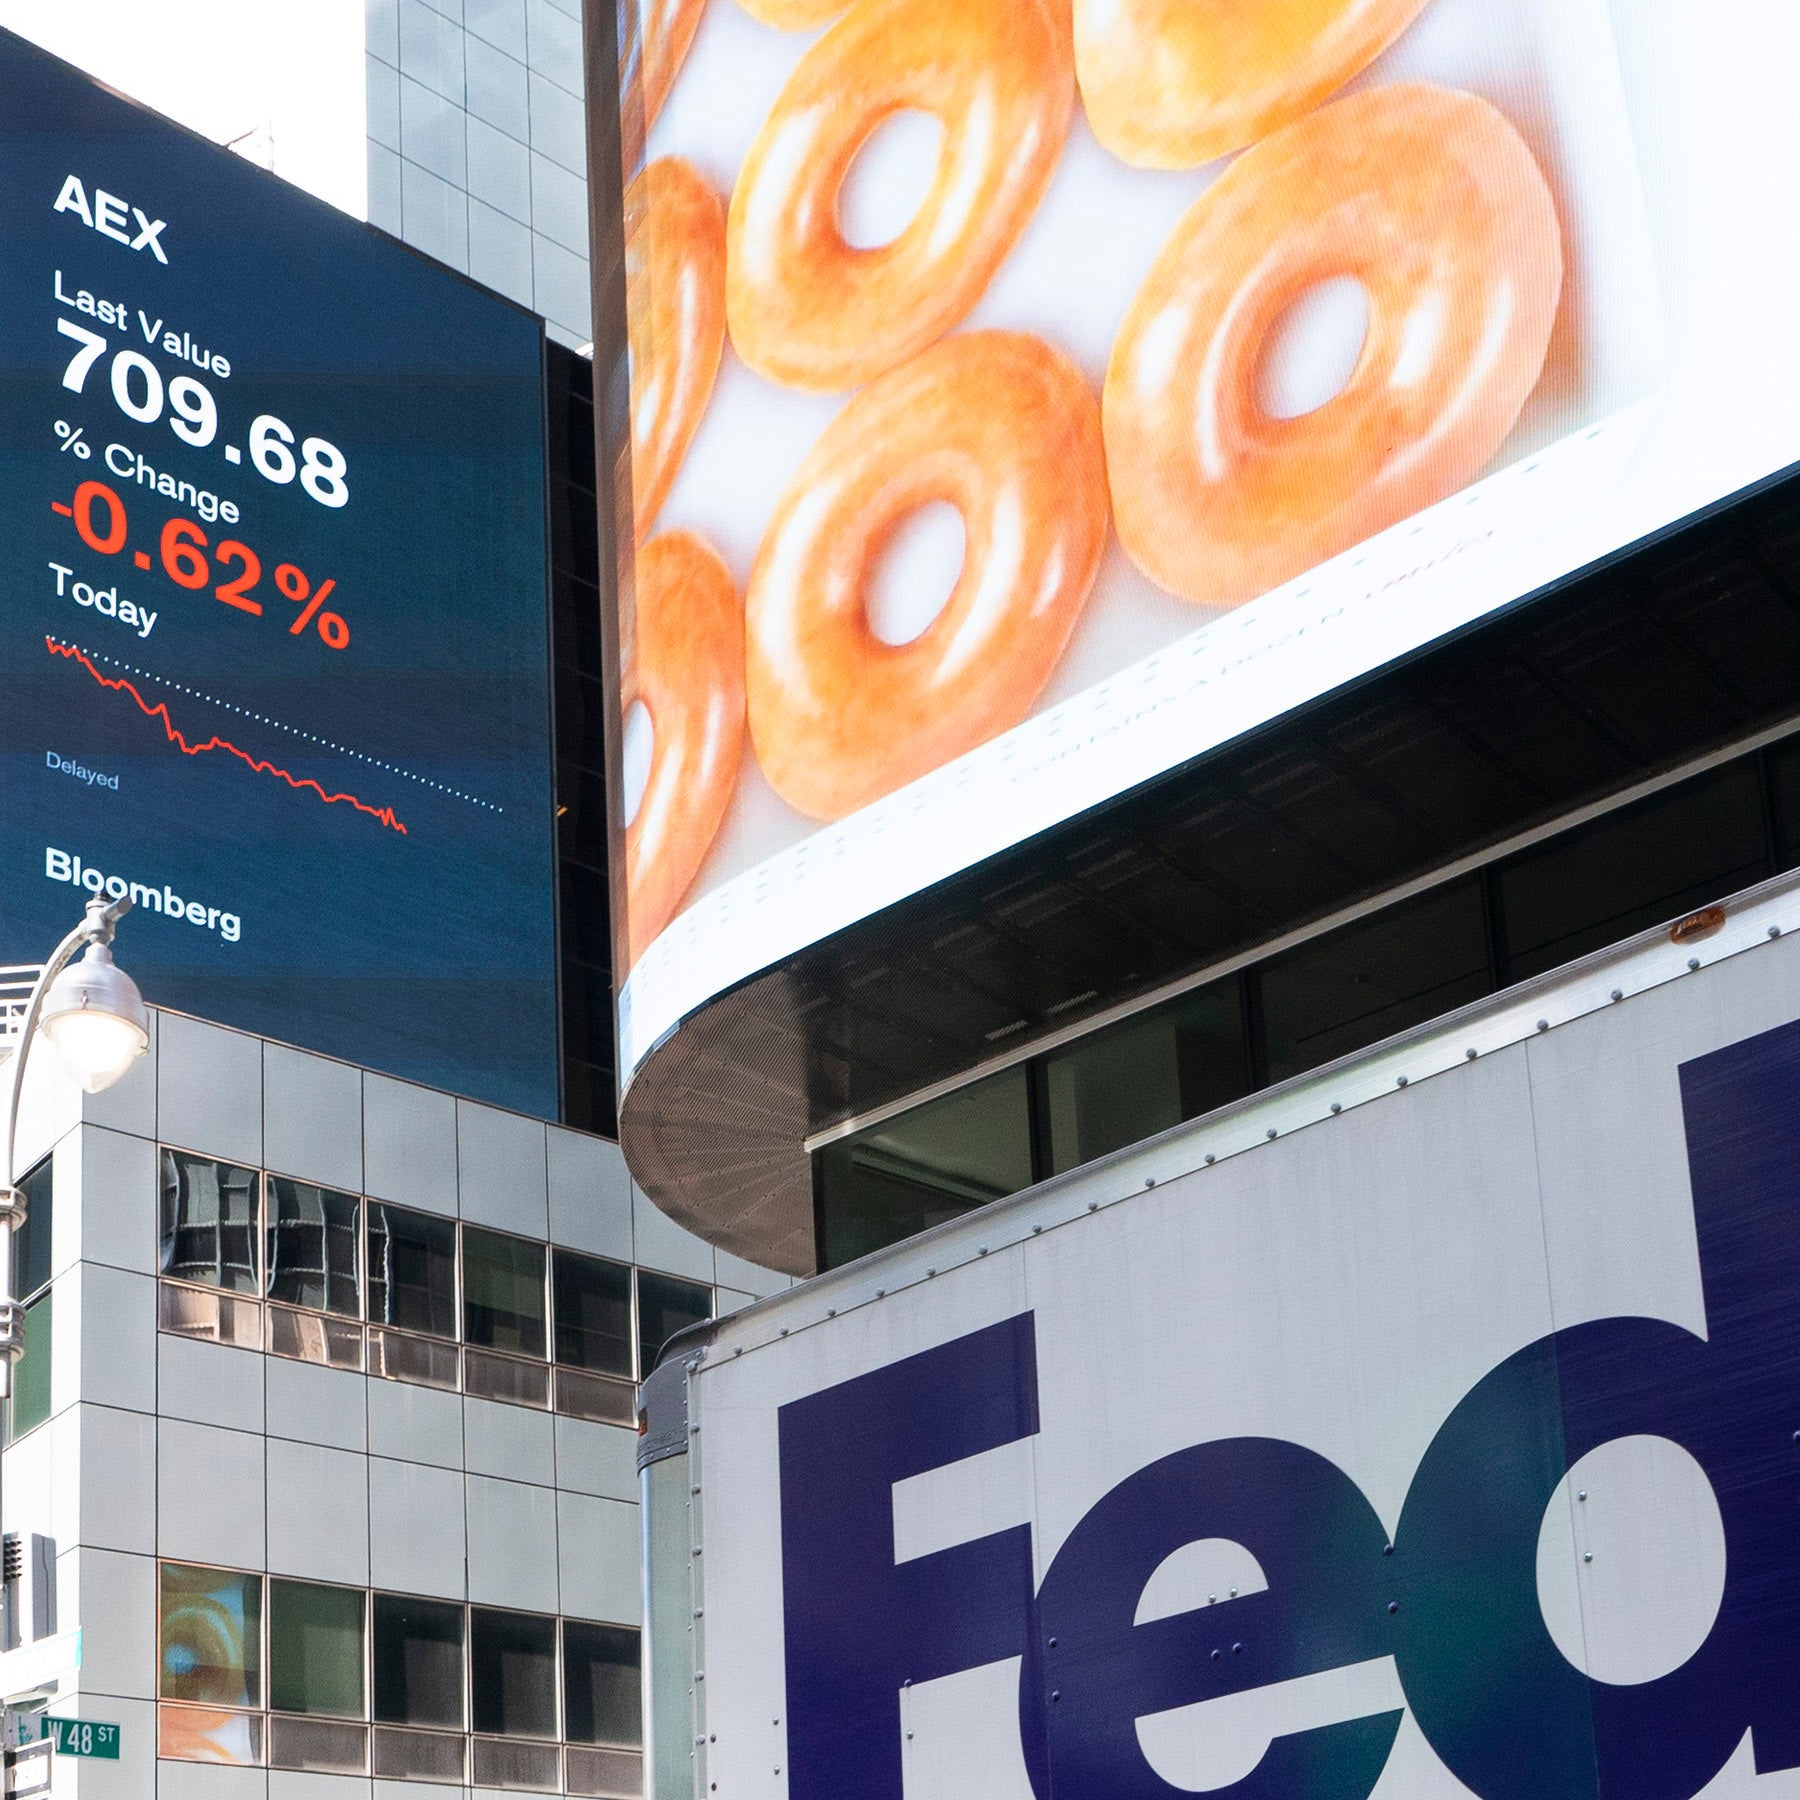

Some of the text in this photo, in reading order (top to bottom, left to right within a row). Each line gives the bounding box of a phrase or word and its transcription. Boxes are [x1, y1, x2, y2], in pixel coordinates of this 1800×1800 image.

[53, 174, 170, 265] AEX
[53, 269, 232, 380] Last Value
[57, 316, 350, 509] 709.68
[54, 420, 241, 526] % Change
[49, 562, 159, 638] Today
[50, 480, 351, 651] -0.62%
[45, 750, 120, 793] Delayed
[45, 847, 242, 943] Bloomberg
[67, 1724, 93, 1754] 48
[97, 1726, 115, 1743] ST
